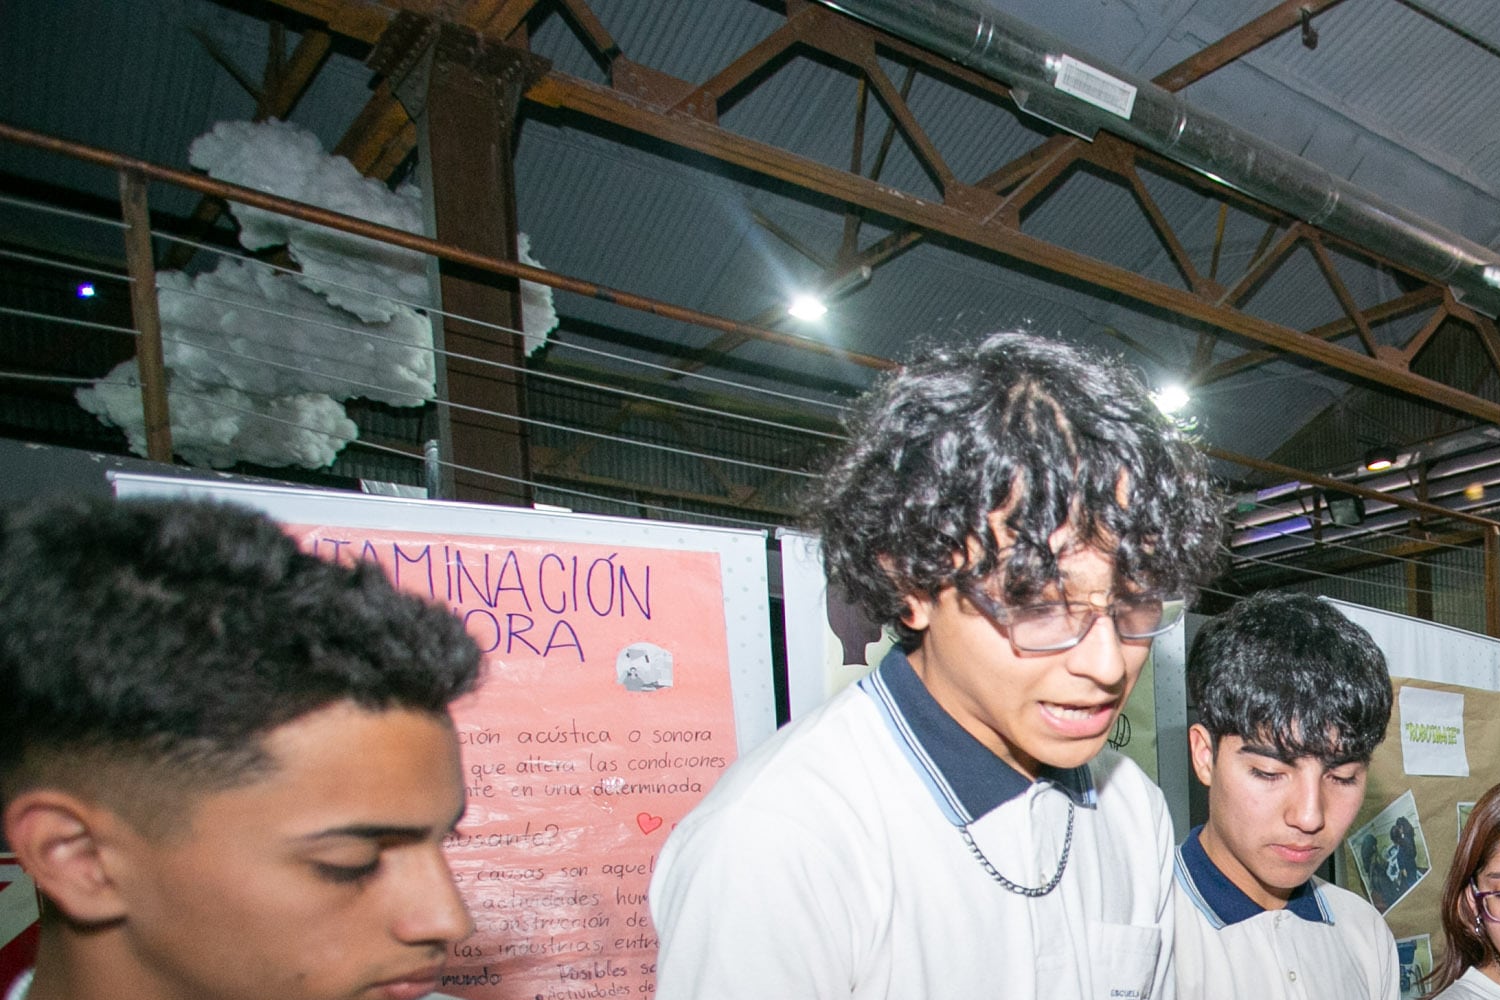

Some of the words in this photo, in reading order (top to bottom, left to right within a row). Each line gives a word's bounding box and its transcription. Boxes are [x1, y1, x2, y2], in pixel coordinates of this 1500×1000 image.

[516, 718, 612, 744] acústica
[628, 729, 641, 743] o
[652, 728, 713, 744] sonora
[471, 763, 506, 783] que
[516, 755, 576, 775] altera
[589, 753, 618, 773] las
[627, 751, 727, 772] condiciones
[511, 785, 533, 798] en
[544, 784, 581, 797] una
[592, 776, 703, 797] determinada
[560, 865, 588, 879] son
[626, 912, 649, 928] de
[441, 966, 502, 987] mundo
